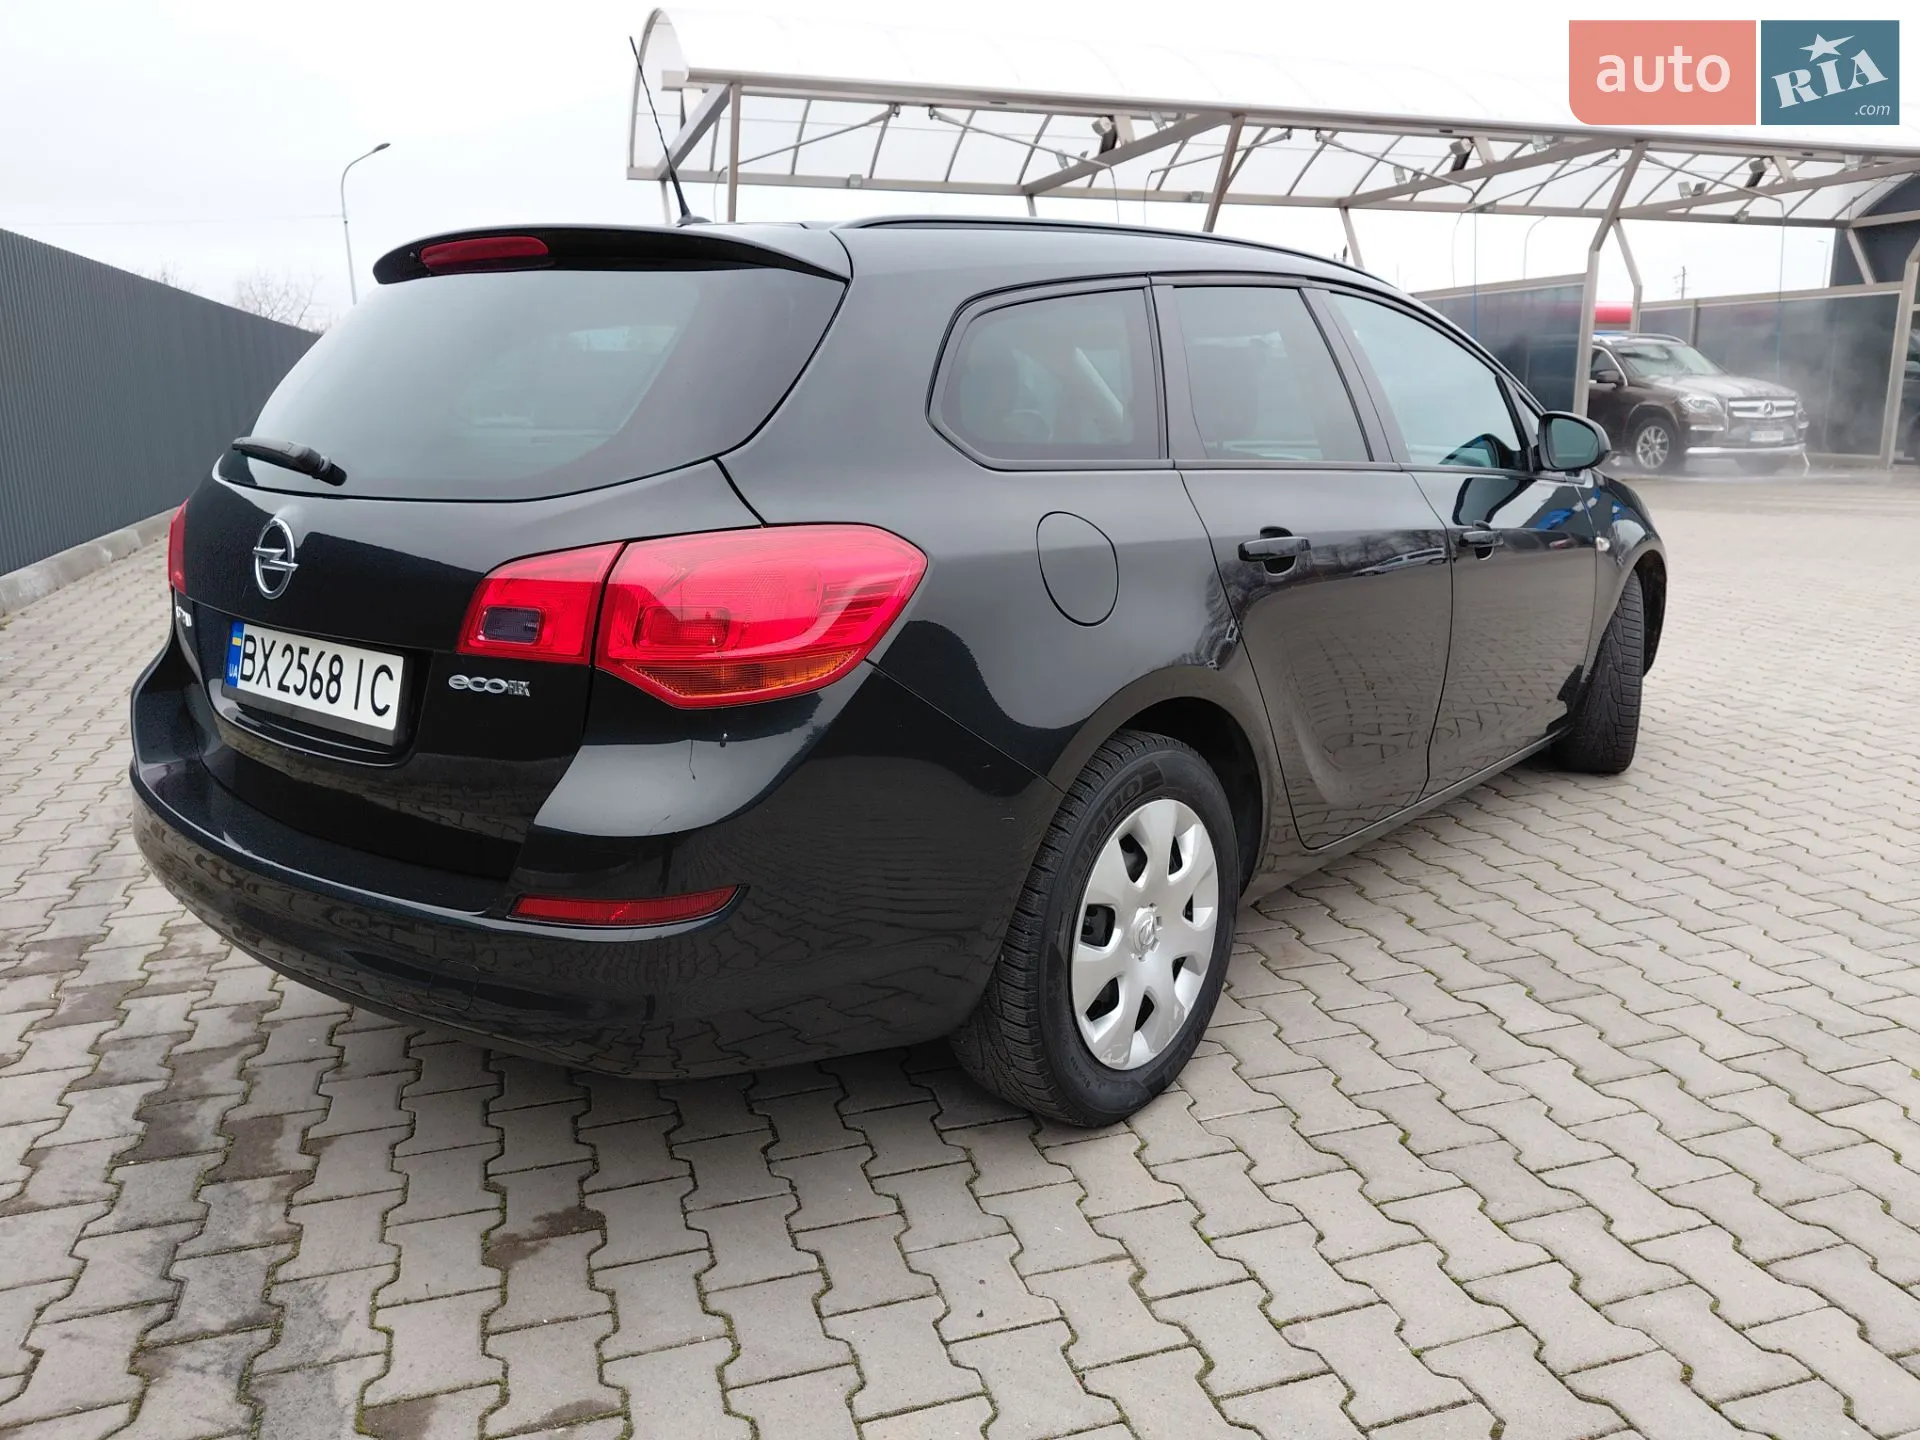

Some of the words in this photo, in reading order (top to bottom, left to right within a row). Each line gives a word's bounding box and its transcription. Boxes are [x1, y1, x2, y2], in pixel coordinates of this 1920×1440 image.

[229, 664, 238, 678] UA
[240, 634, 276, 688] BX
[277, 644, 343, 704] 2568
[354, 659, 394, 716] IC
